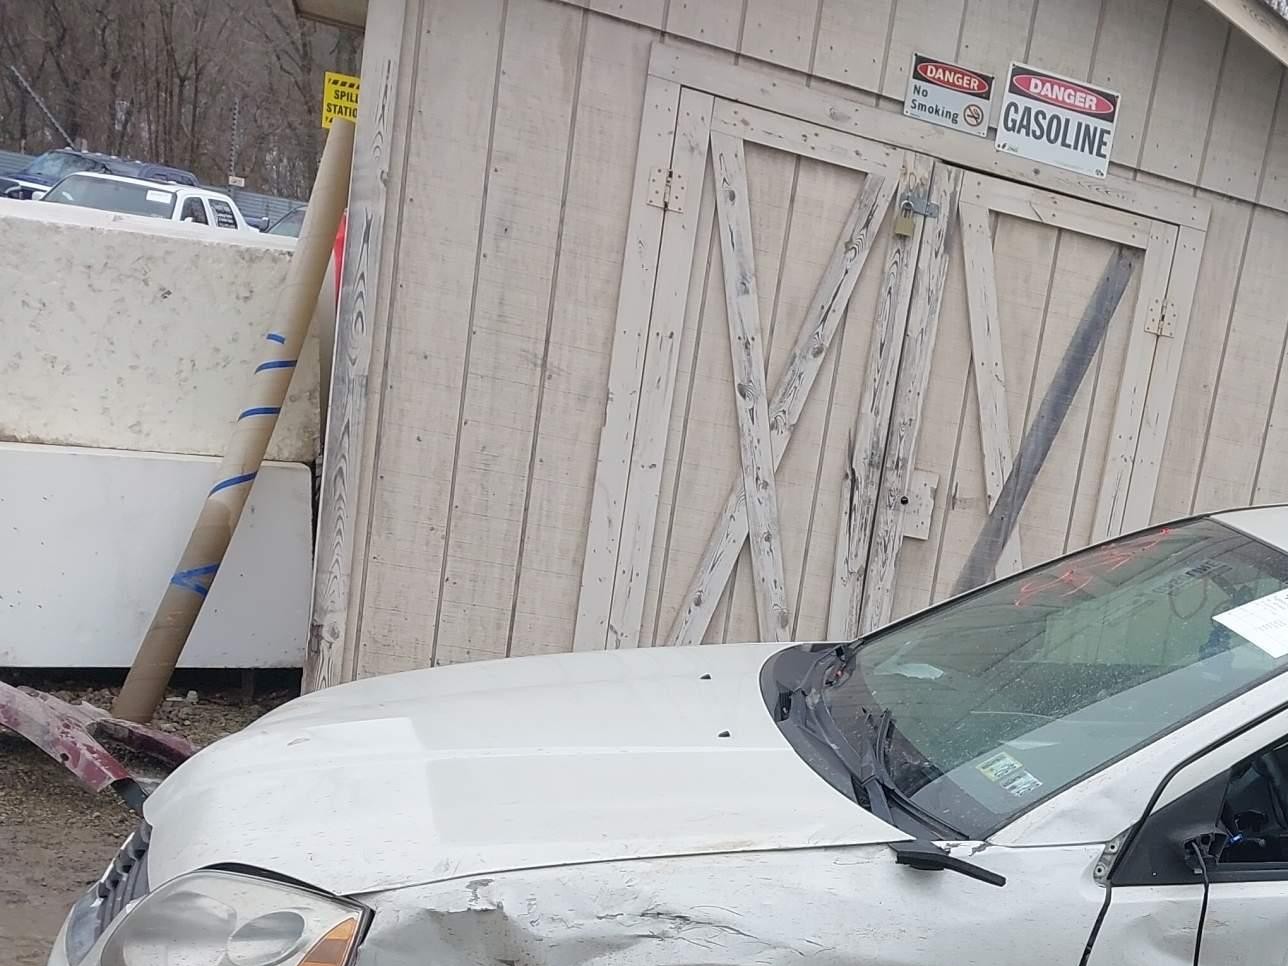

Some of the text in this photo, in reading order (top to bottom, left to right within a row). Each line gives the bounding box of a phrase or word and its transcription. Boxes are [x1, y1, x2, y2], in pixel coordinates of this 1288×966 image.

[912, 84, 929, 98] No
[926, 64, 980, 92] DANGER
[334, 89, 359, 104] SPILL
[1029, 78, 1098, 112] DANGER
[326, 102, 358, 119] STATIO
[910, 98, 960, 125] Smoking
[1003, 101, 1112, 159] GASOLINE
